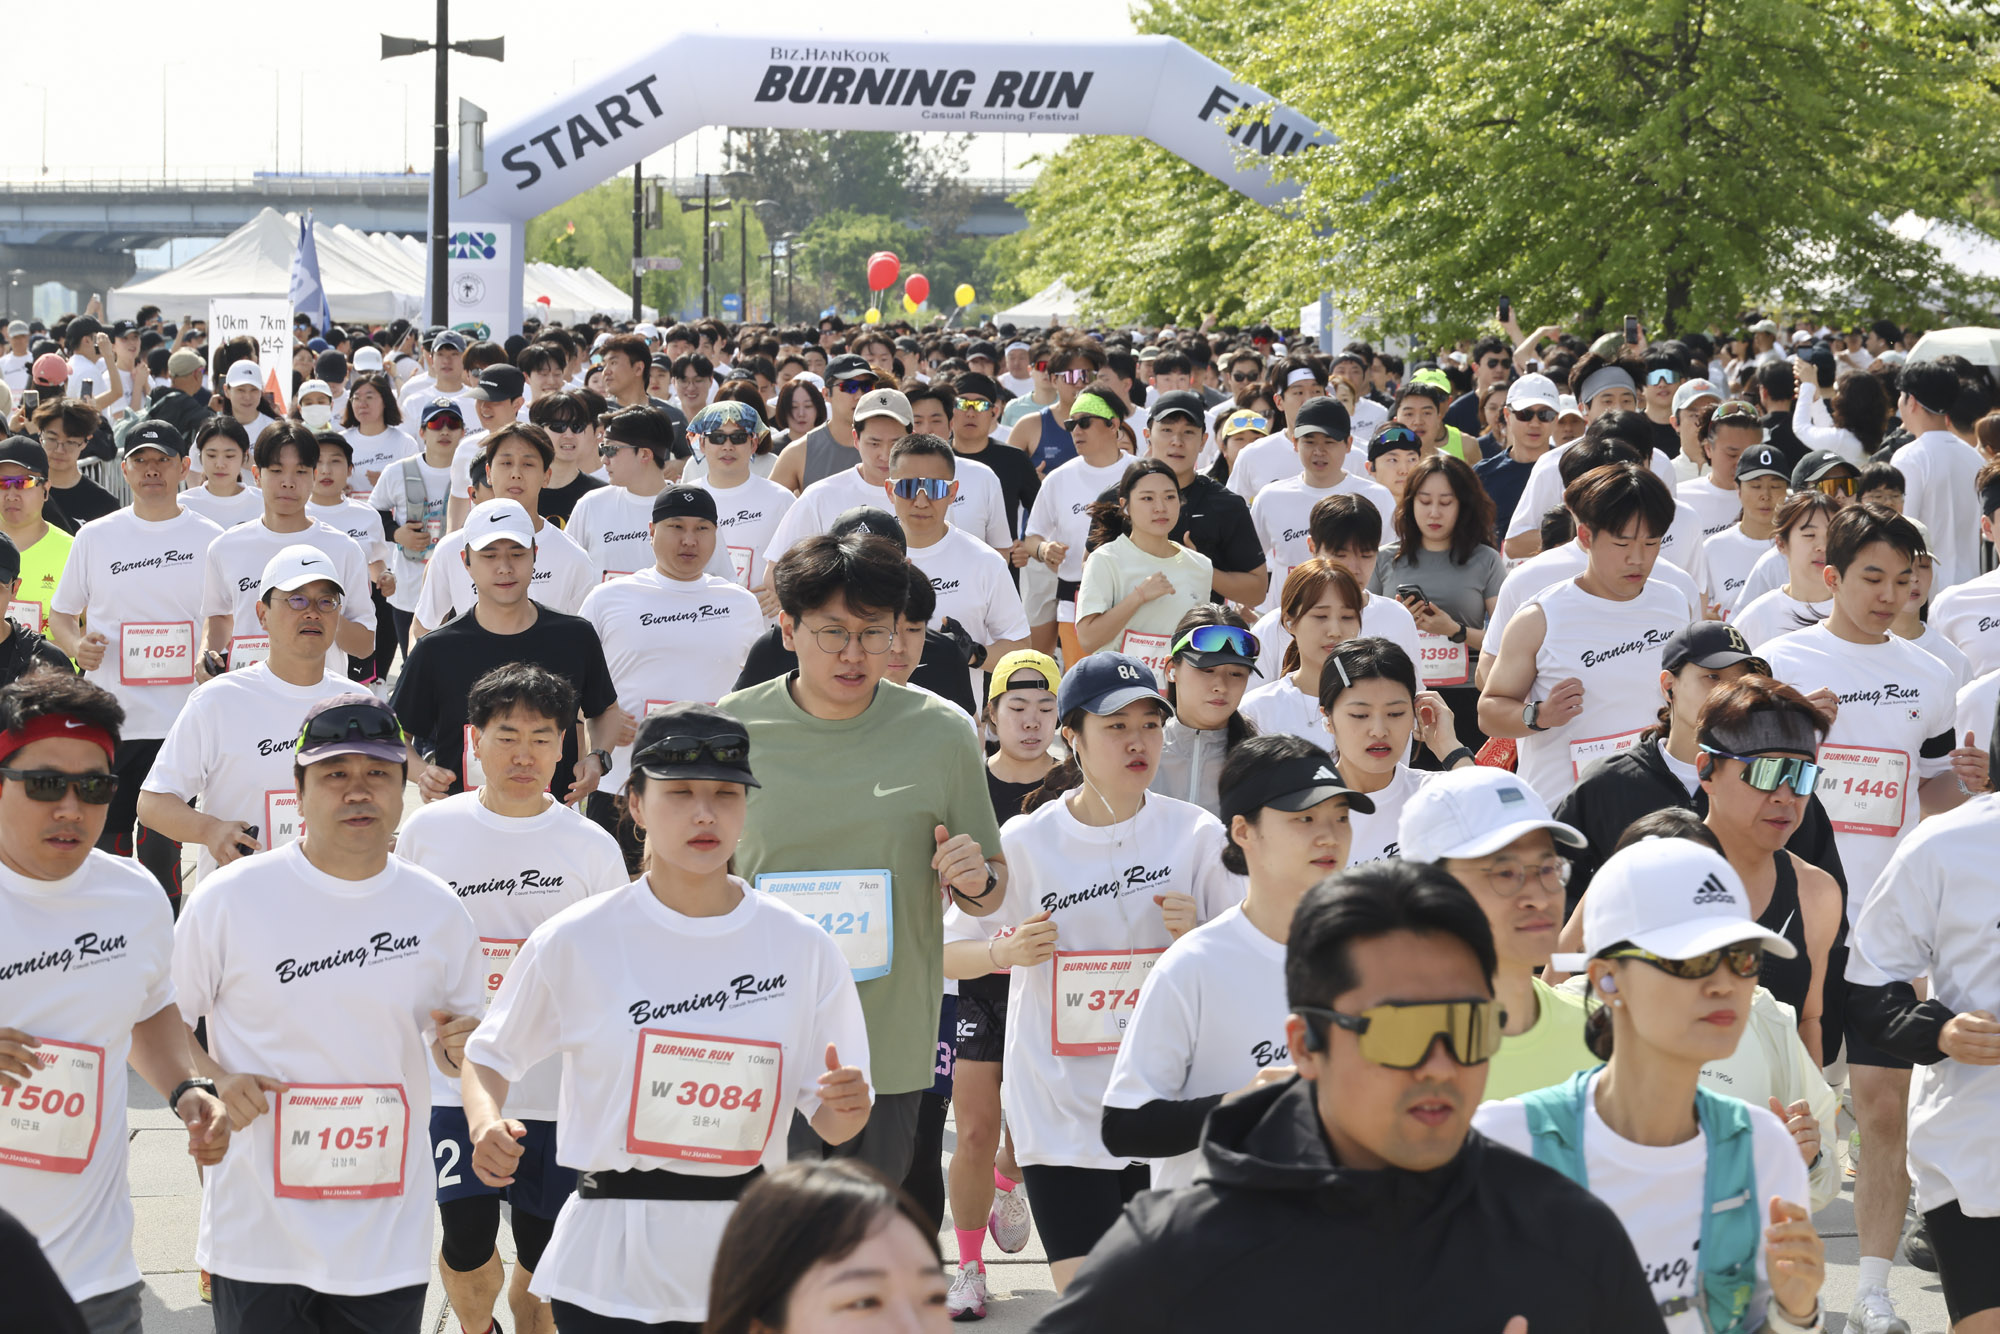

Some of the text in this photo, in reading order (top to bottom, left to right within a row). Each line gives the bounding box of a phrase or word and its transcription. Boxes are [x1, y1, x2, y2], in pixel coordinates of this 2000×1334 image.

[754, 65, 1094, 109] BURNING RUN
[921, 110, 1079, 123] Casual Running Festival
[1198, 85, 1320, 157] FINI
[501, 73, 664, 190] START
[216, 314, 286, 330] 10km 7km
[261, 336, 284, 353] 선수
[737, 510, 763, 521] Run
[348, 528, 368, 539] Run
[603, 530, 648, 543] Burning
[110, 550, 194, 575] Burning Run
[930, 577, 960, 591] Run
[640, 610, 698, 626] Burning
[699, 604, 731, 618] Run
[129, 644, 187, 659] M 1052
[1580, 640, 1645, 668] Burning
[1117, 664, 1141, 680] 84
[1883, 683, 1920, 700] Run
[1577, 739, 1632, 754] A-114 RUN
[1823, 752, 1861, 763] BURNING
[1861, 755, 1880, 764] RUN
[1822, 777, 1899, 799] M 1446
[279, 823, 293, 835] M
[519, 869, 564, 890] Run
[768, 881, 879, 893] BURNING RUN 7km
[1041, 865, 1172, 914] Burning Run
[1693, 893, 1737, 905] adidas
[74, 932, 128, 961] Run
[491, 948, 511, 957] RUN
[275, 931, 421, 984] Burning Run
[1062, 962, 1108, 972] BURNING
[1109, 961, 1132, 971] RUN
[628, 973, 787, 1025] Burning Run
[1065, 993, 1084, 1007] W
[652, 1043, 775, 1065] BURNING RUN 10km
[71, 1059, 94, 1070] 10km
[1, 1085, 85, 1118] 1500
[289, 1096, 340, 1107] BURNING
[341, 1096, 364, 1107] RUN
[651, 1080, 763, 1113] W 3084
[291, 1126, 390, 1151] M 1051
[434, 1138, 462, 1189] 2
